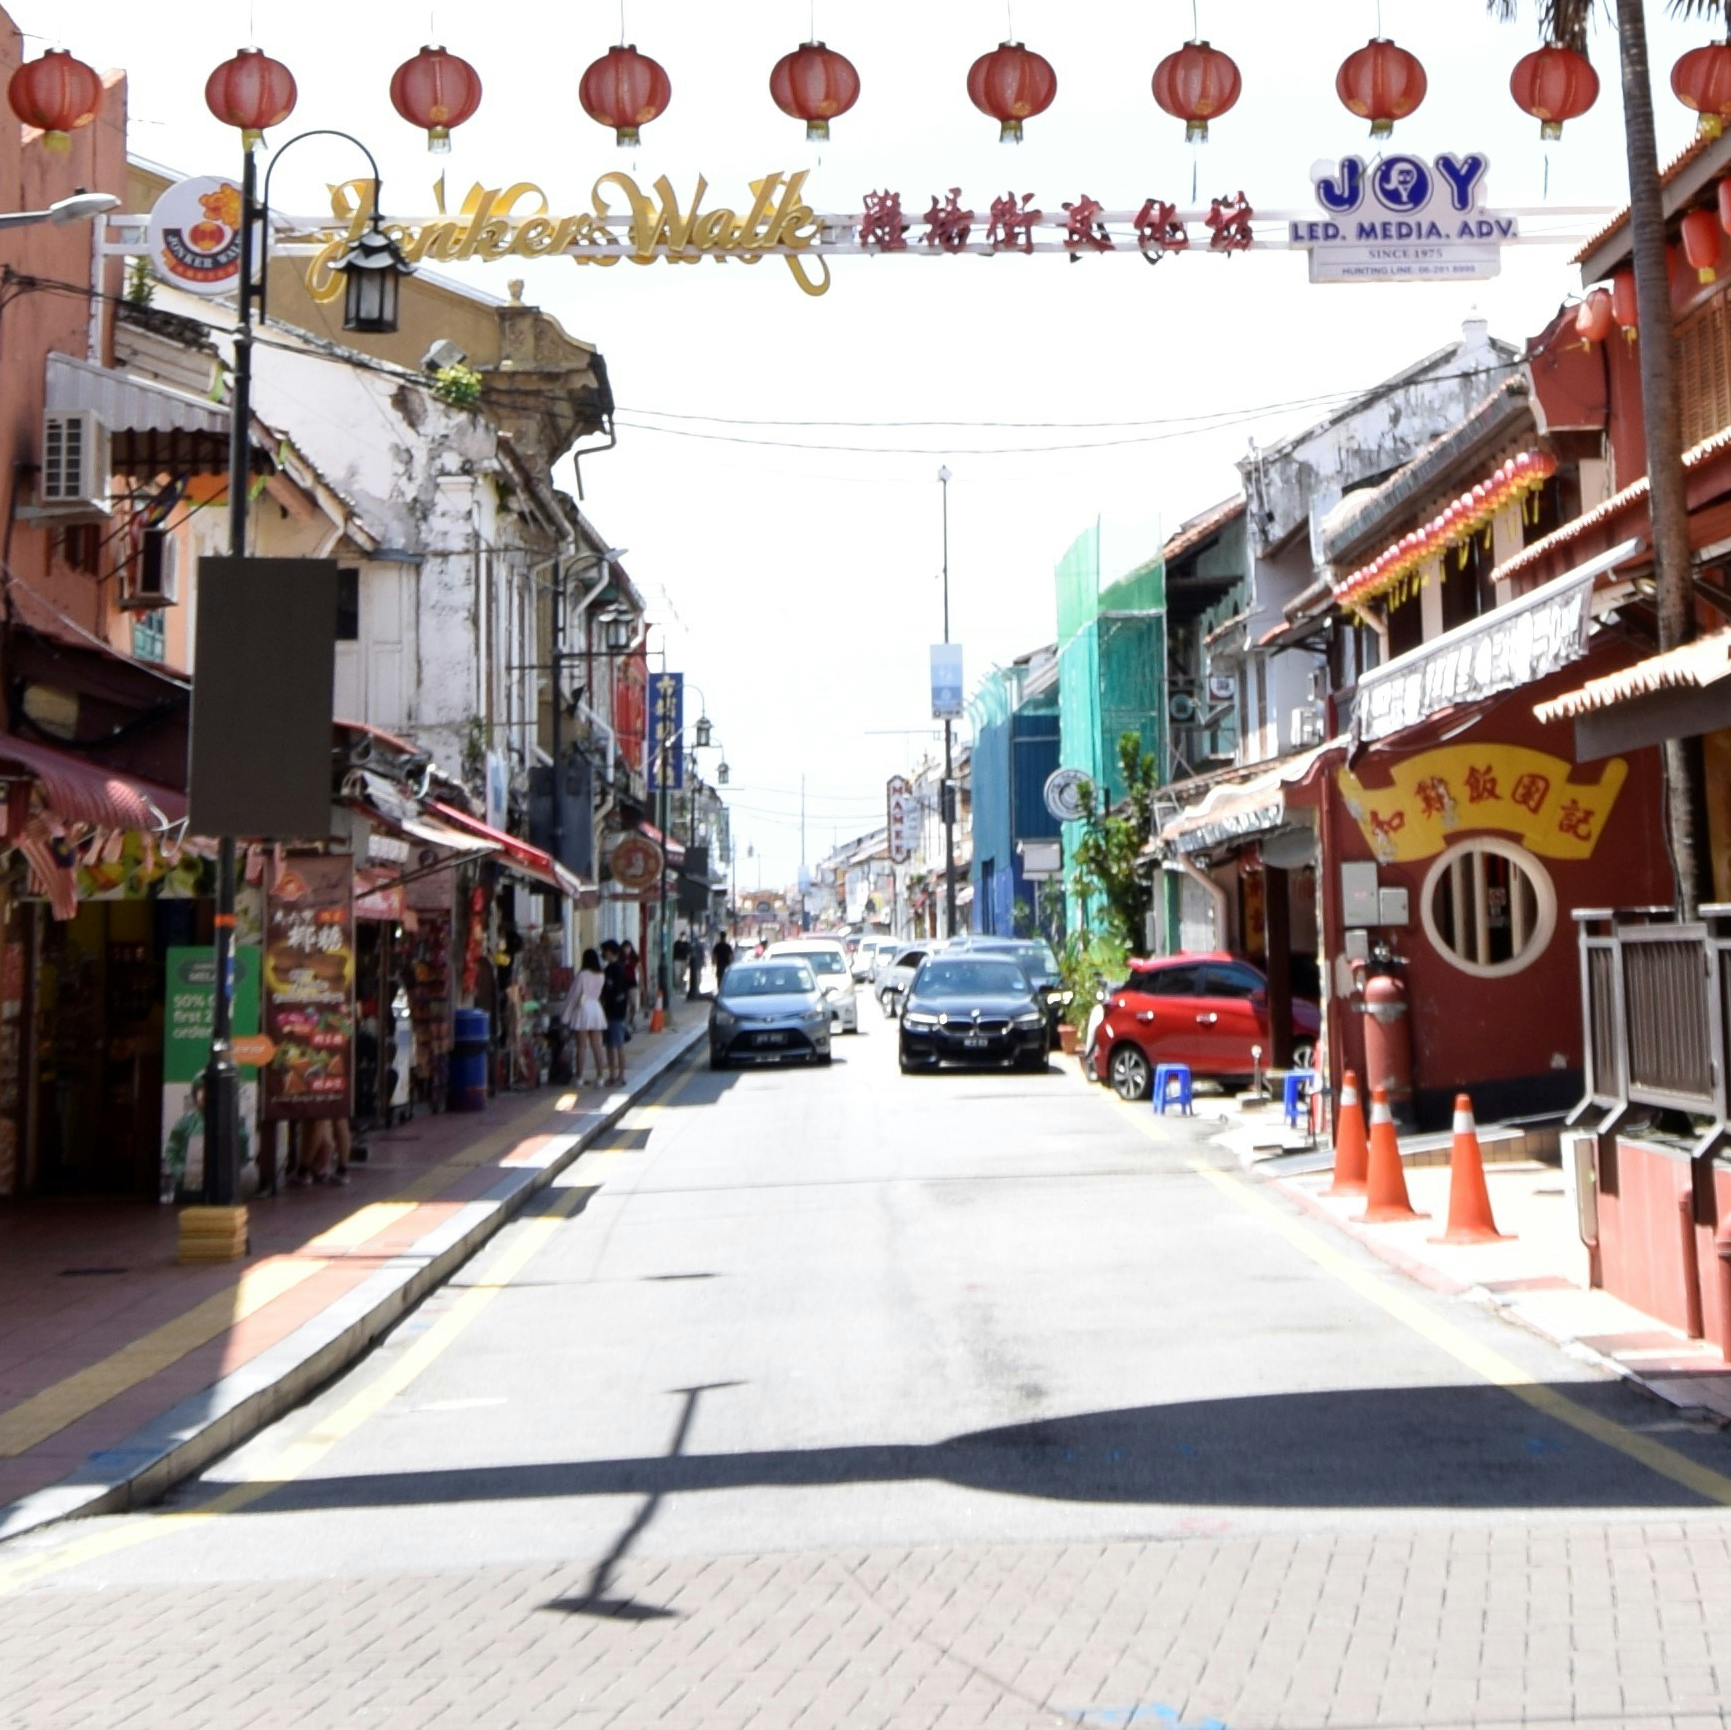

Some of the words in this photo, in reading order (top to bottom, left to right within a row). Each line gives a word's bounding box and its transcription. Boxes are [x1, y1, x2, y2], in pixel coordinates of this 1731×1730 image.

[1316, 153, 1488, 214] JOY
[592, 169, 826, 256] Walk
[1291, 220, 1347, 242] LED.
[1355, 219, 1451, 241] MEDIA.
[1456, 219, 1518, 240] ADV.
[1369, 249, 1410, 260] SINCE
[1415, 248, 1443, 259] 1975
